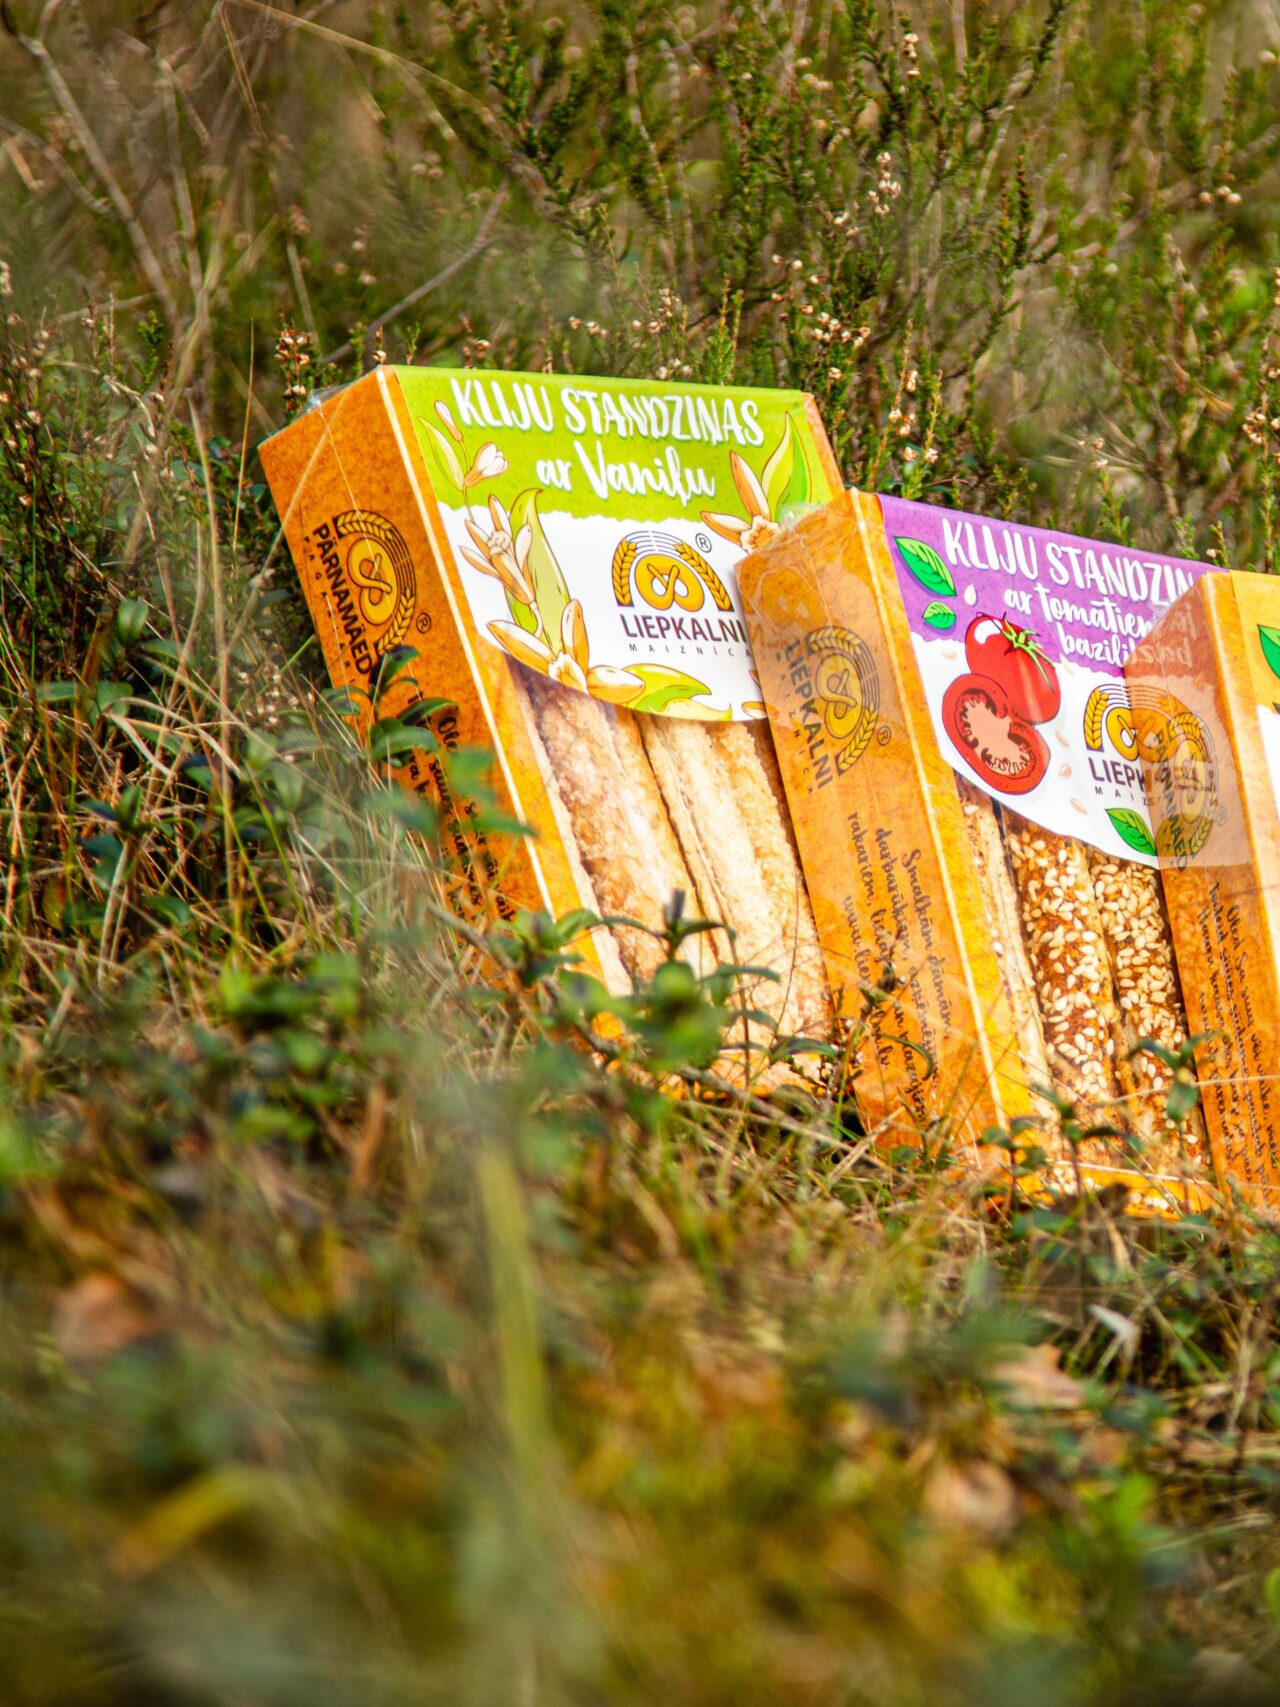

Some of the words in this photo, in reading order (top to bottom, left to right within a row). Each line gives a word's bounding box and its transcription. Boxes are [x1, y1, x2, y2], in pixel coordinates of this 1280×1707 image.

[450, 378, 554, 432] KLIJU
[560, 387, 765, 447] STANDZIŅAS
[536, 458, 573, 492] ar
[942, 518, 1039, 581] KLIJU
[312, 522, 373, 676] PÄRNAMÄED
[620, 613, 748, 644] LIEPKALNI
[1004, 587, 1033, 616] ar
[784, 639, 834, 790] LIEPKALNI
